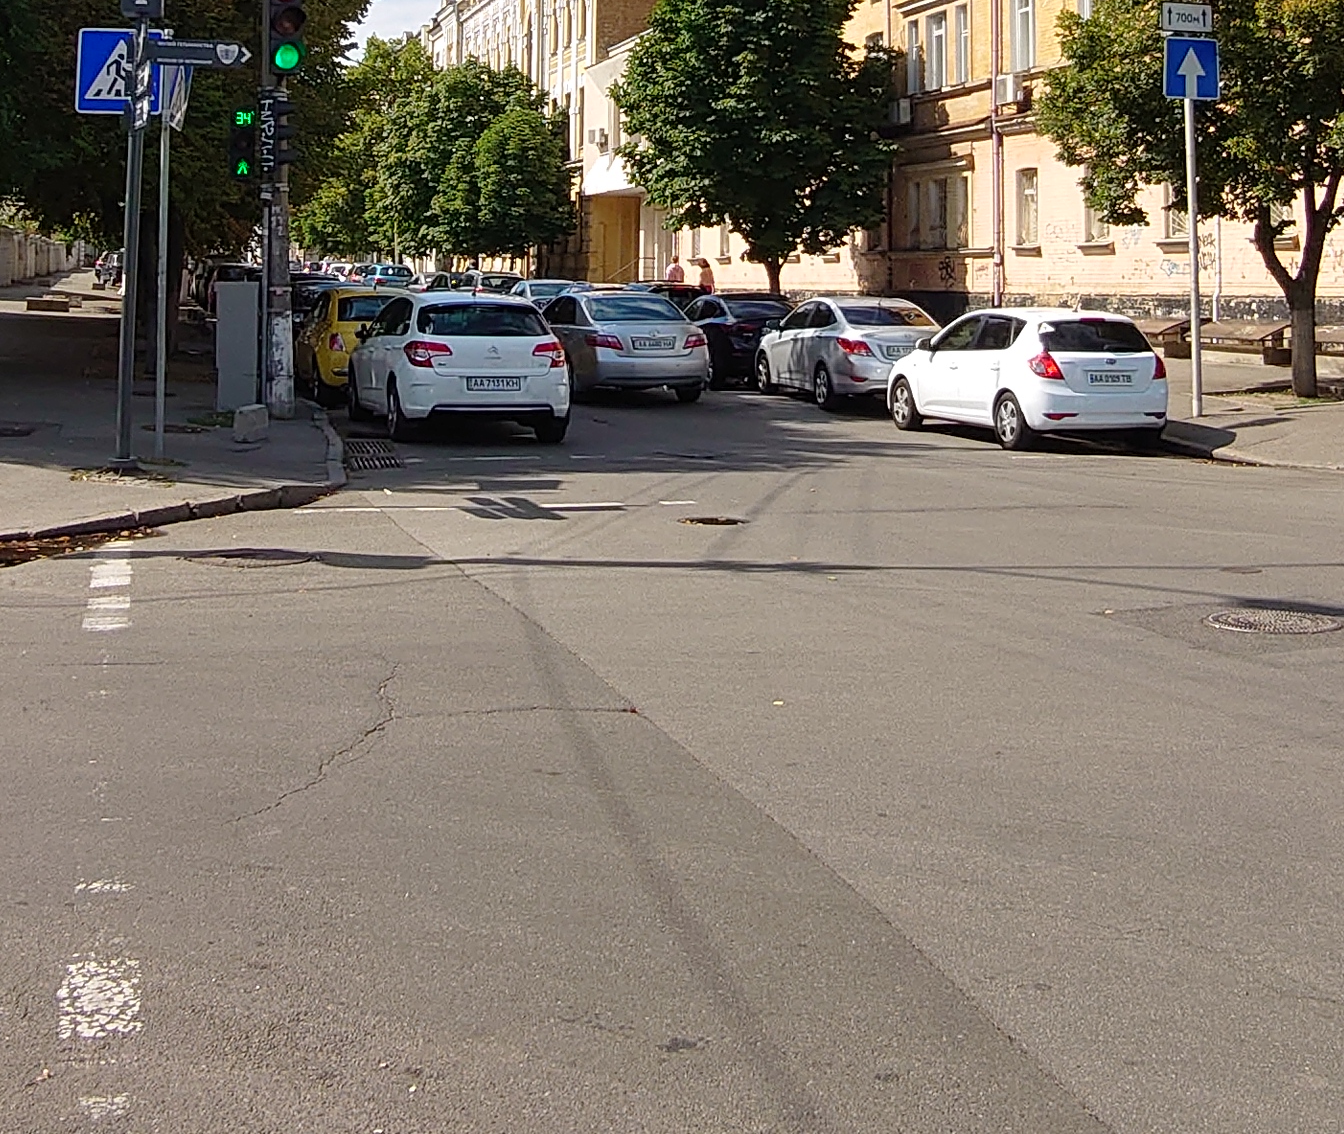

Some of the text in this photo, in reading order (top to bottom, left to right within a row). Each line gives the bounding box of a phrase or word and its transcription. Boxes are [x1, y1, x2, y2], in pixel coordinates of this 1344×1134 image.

[236, 111, 252, 125] 34
[473, 379, 485, 387] AA
[506, 379, 519, 387] KH
